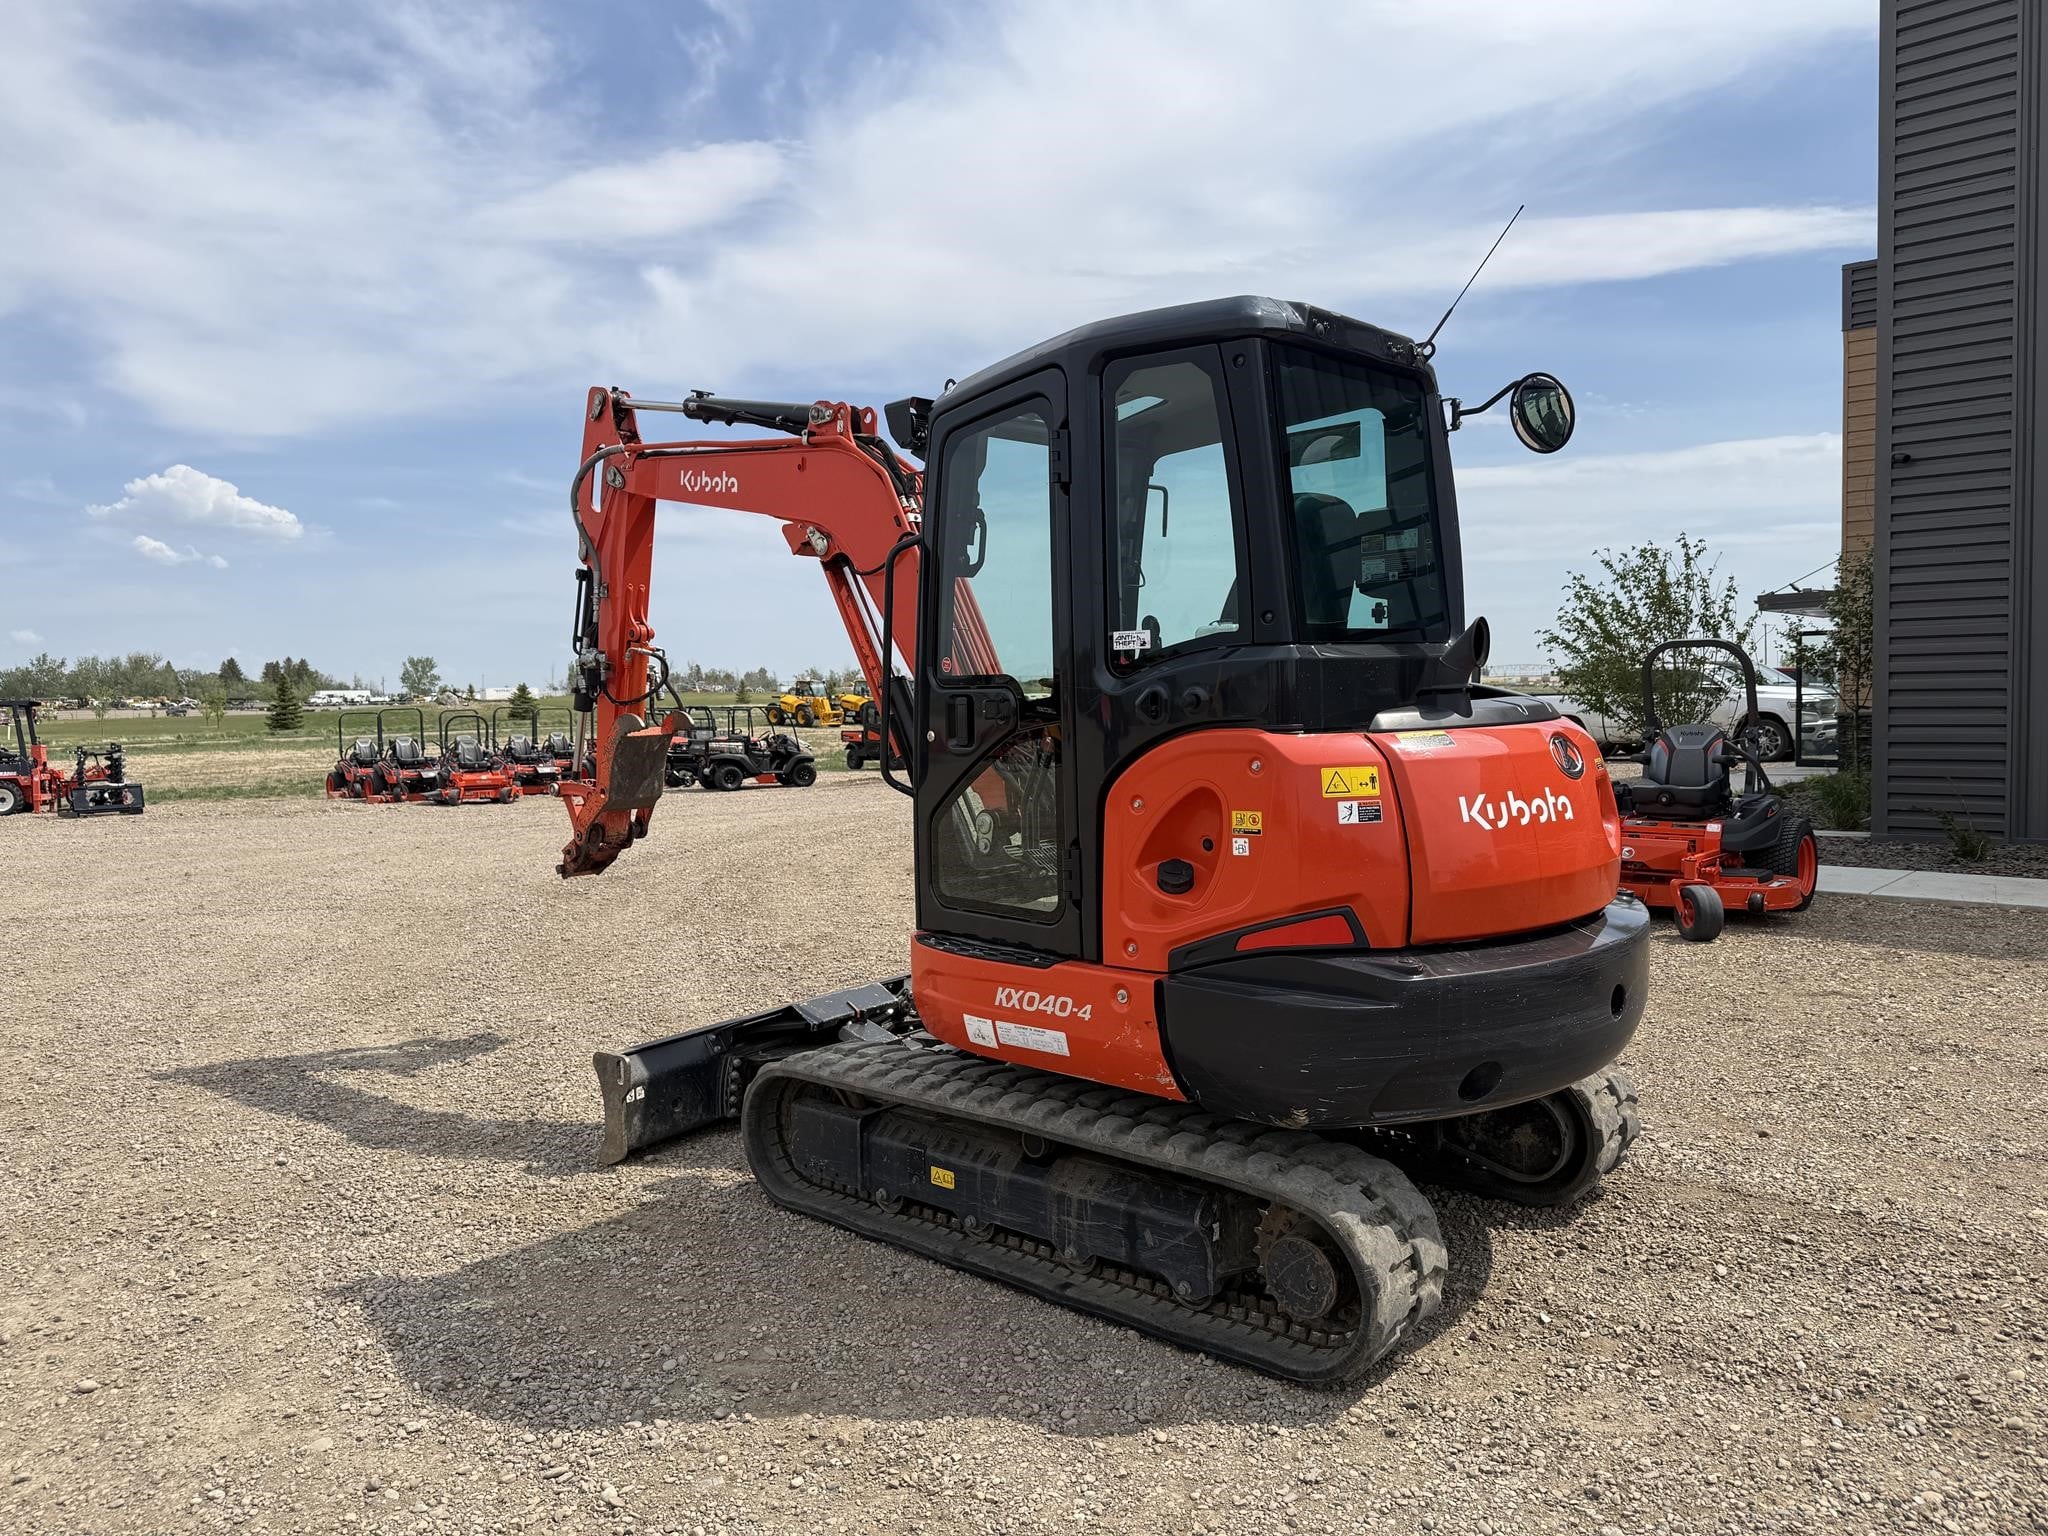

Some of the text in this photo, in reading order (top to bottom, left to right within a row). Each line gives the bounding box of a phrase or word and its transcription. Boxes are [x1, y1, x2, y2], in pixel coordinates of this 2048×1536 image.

[680, 470, 738, 493] Kubota
[1458, 786, 1574, 831] Kubota
[994, 986, 1092, 1021] KX040-4
